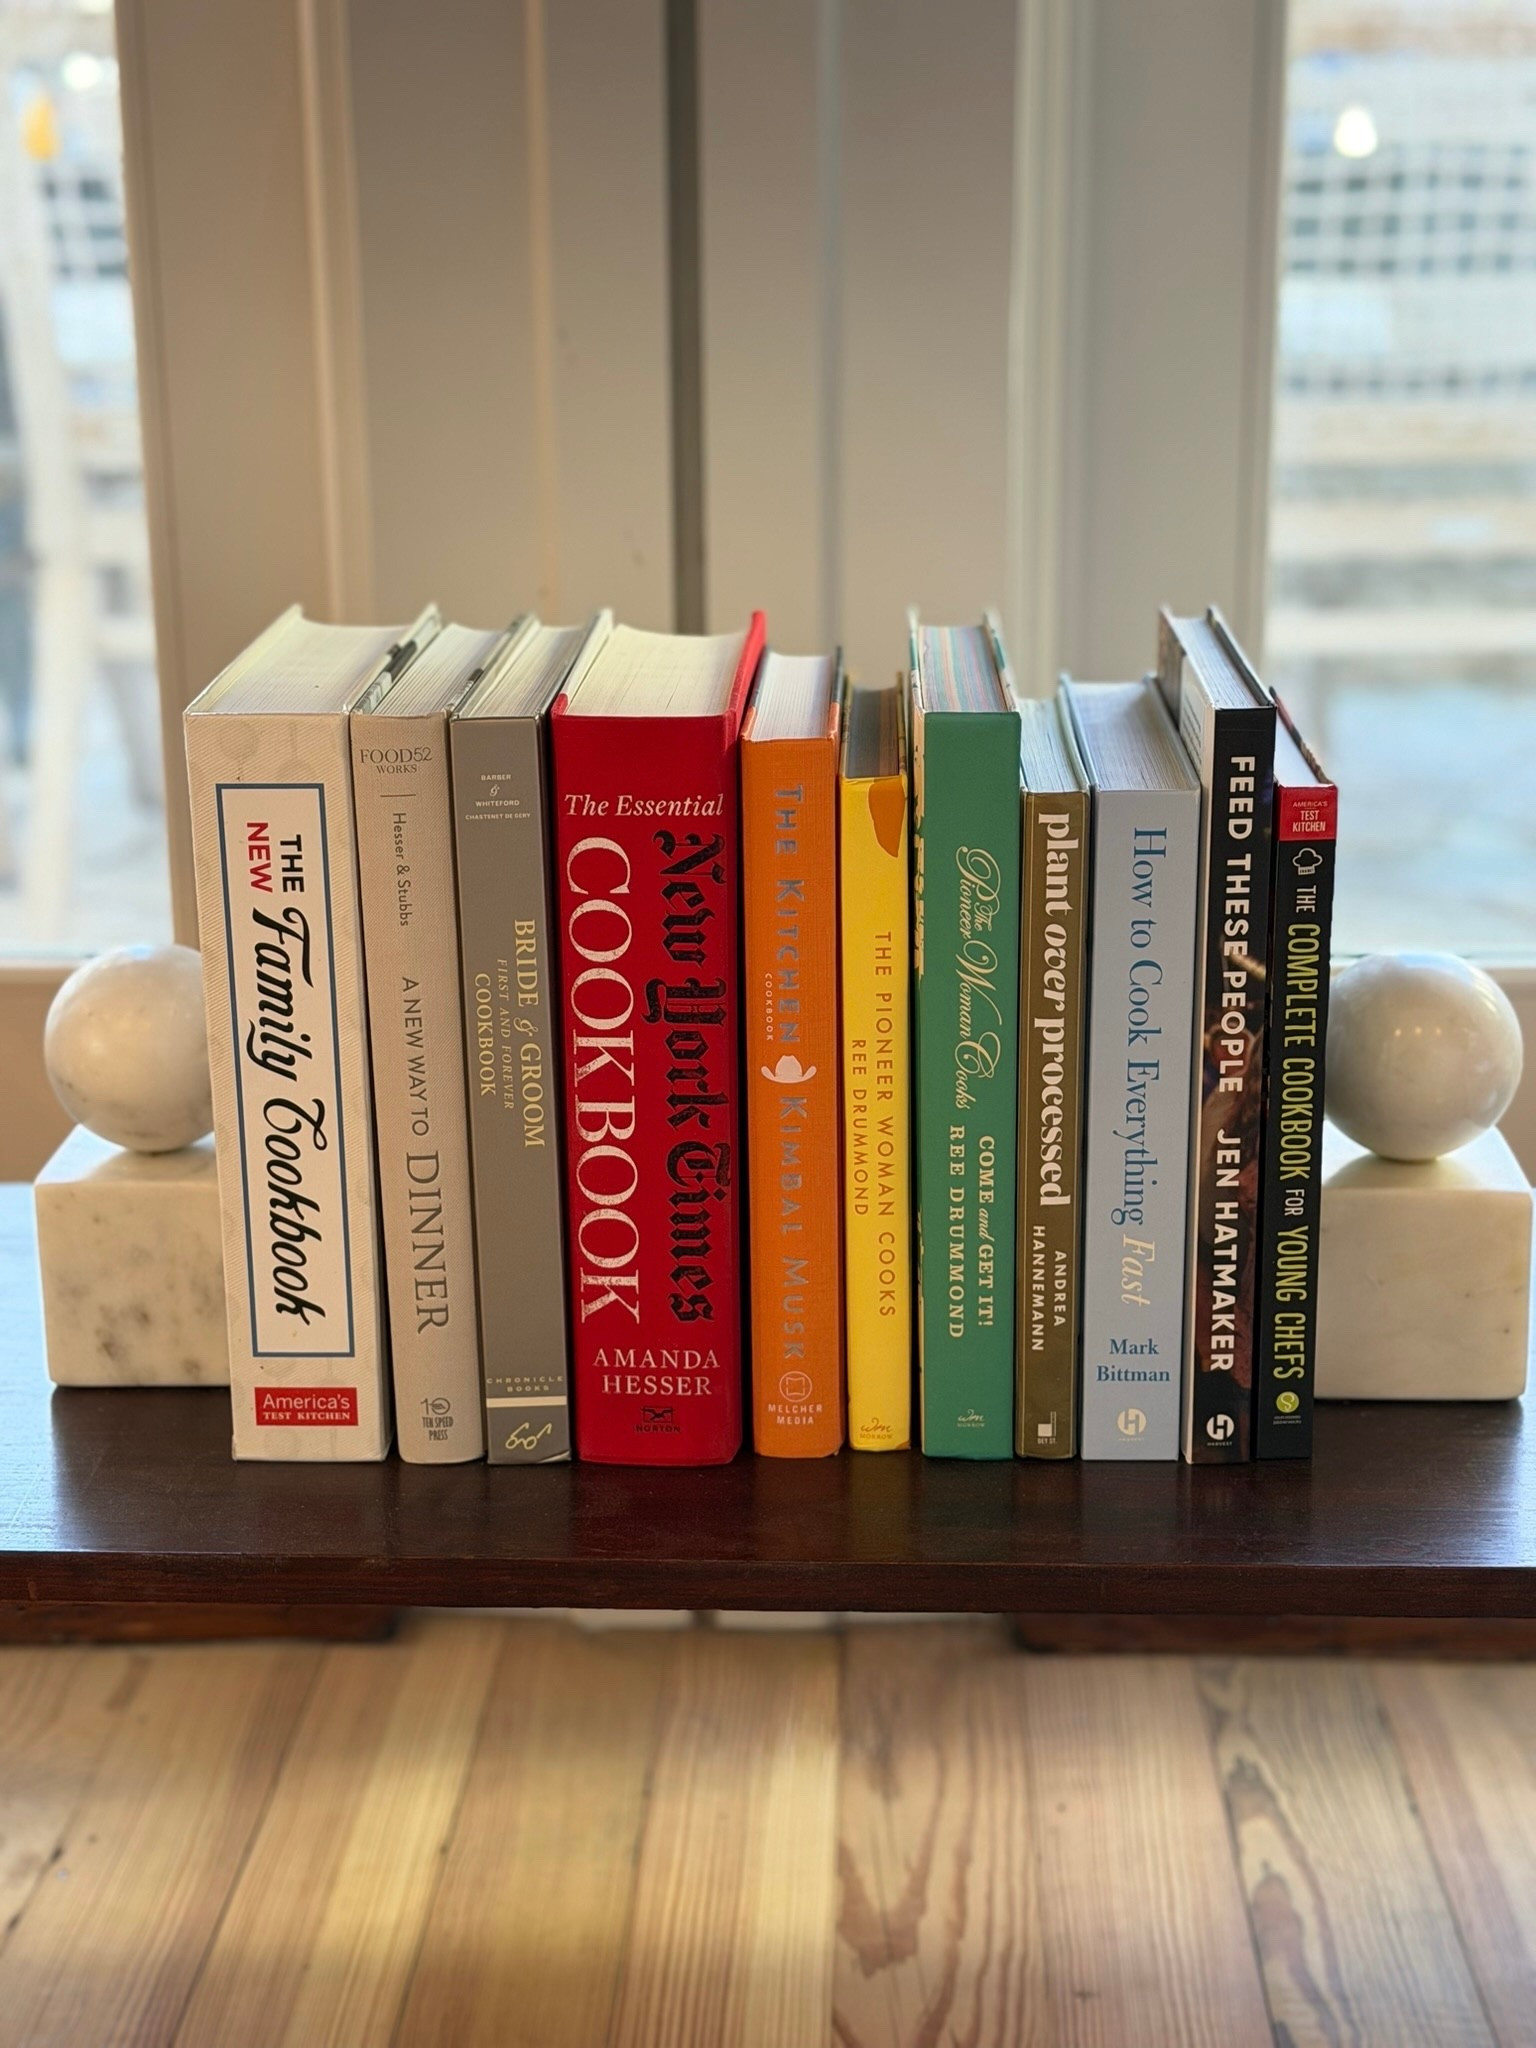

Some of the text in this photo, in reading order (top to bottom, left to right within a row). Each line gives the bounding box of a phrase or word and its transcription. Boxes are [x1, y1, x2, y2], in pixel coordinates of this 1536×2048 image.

[360, 747, 433, 765] FOOD52
[376, 764, 418, 775] WORKS
[489, 784, 500, 797] &
[565, 793, 724, 816] The Essential
[1292, 821, 1327, 833] KITCHEN
[1300, 810, 1320, 820] TEST
[246, 822, 274, 893] NEW
[279, 834, 305, 893] THE
[392, 812, 412, 927] Hesser & Stubbs
[775, 784, 805, 1044] THE KITCHEN
[1295, 885, 1317, 914] THE
[765, 973, 774, 1041] COOKBOOK
[955, 846, 1003, 1110] Pioneer Woman Cooks
[1034, 812, 1079, 1206] plant over processed
[1285, 925, 1320, 1048] COMPLETE
[475, 973, 496, 1097] COOKBOOK
[497, 958, 514, 1110] FIRST AND FOREVER
[514, 919, 546, 1148] BRIDE & GROOM
[1110, 826, 1168, 1309] How to Cook Everything Fast
[1209, 755, 1256, 1372] FEED THESE PEOPLE JEN HATMAKER
[566, 836, 640, 1324] COOKBOOK
[641, 829, 732, 1322] New York Times
[246, 907, 328, 1326] Family Cookbook
[852, 1039, 869, 1216] REE DRUMMOND
[874, 931, 896, 1317] THE PIONEER WOMAN COOKS
[1279, 1053, 1316, 1181] COOKBOOK
[402, 976, 451, 1334] A NEW WAY TO DINNER
[778, 1095, 808, 1360] KIMBAL MUSK
[948, 1125, 965, 1339] REE DRUMMOND
[978, 1135, 995, 1327] COME and GET IT!
[1284, 1188, 1306, 1217] FOR
[1031, 1225, 1046, 1351] HANNEMANN
[1053, 1250, 1067, 1327] ANDREA
[1276, 1225, 1309, 1302] YOUNG
[486, 1376, 563, 1384] CHRONICLE
[593, 1348, 721, 1369] AMANDA
[1096, 1364, 1170, 1383] Bittman
[1109, 1338, 1159, 1356] Mark
[1272, 1312, 1307, 1379] CHEFS
[263, 1393, 351, 1409] America's
[263, 1412, 351, 1420] TEST KITCHEN
[602, 1375, 713, 1396] HESSER
[768, 1403, 823, 1414] MELCHER
[776, 1415, 815, 1426] MEDIA
[422, 1416, 454, 1428] TEN SPEED
[428, 1430, 448, 1441] PRESS
[635, 1424, 681, 1433] NORTON
